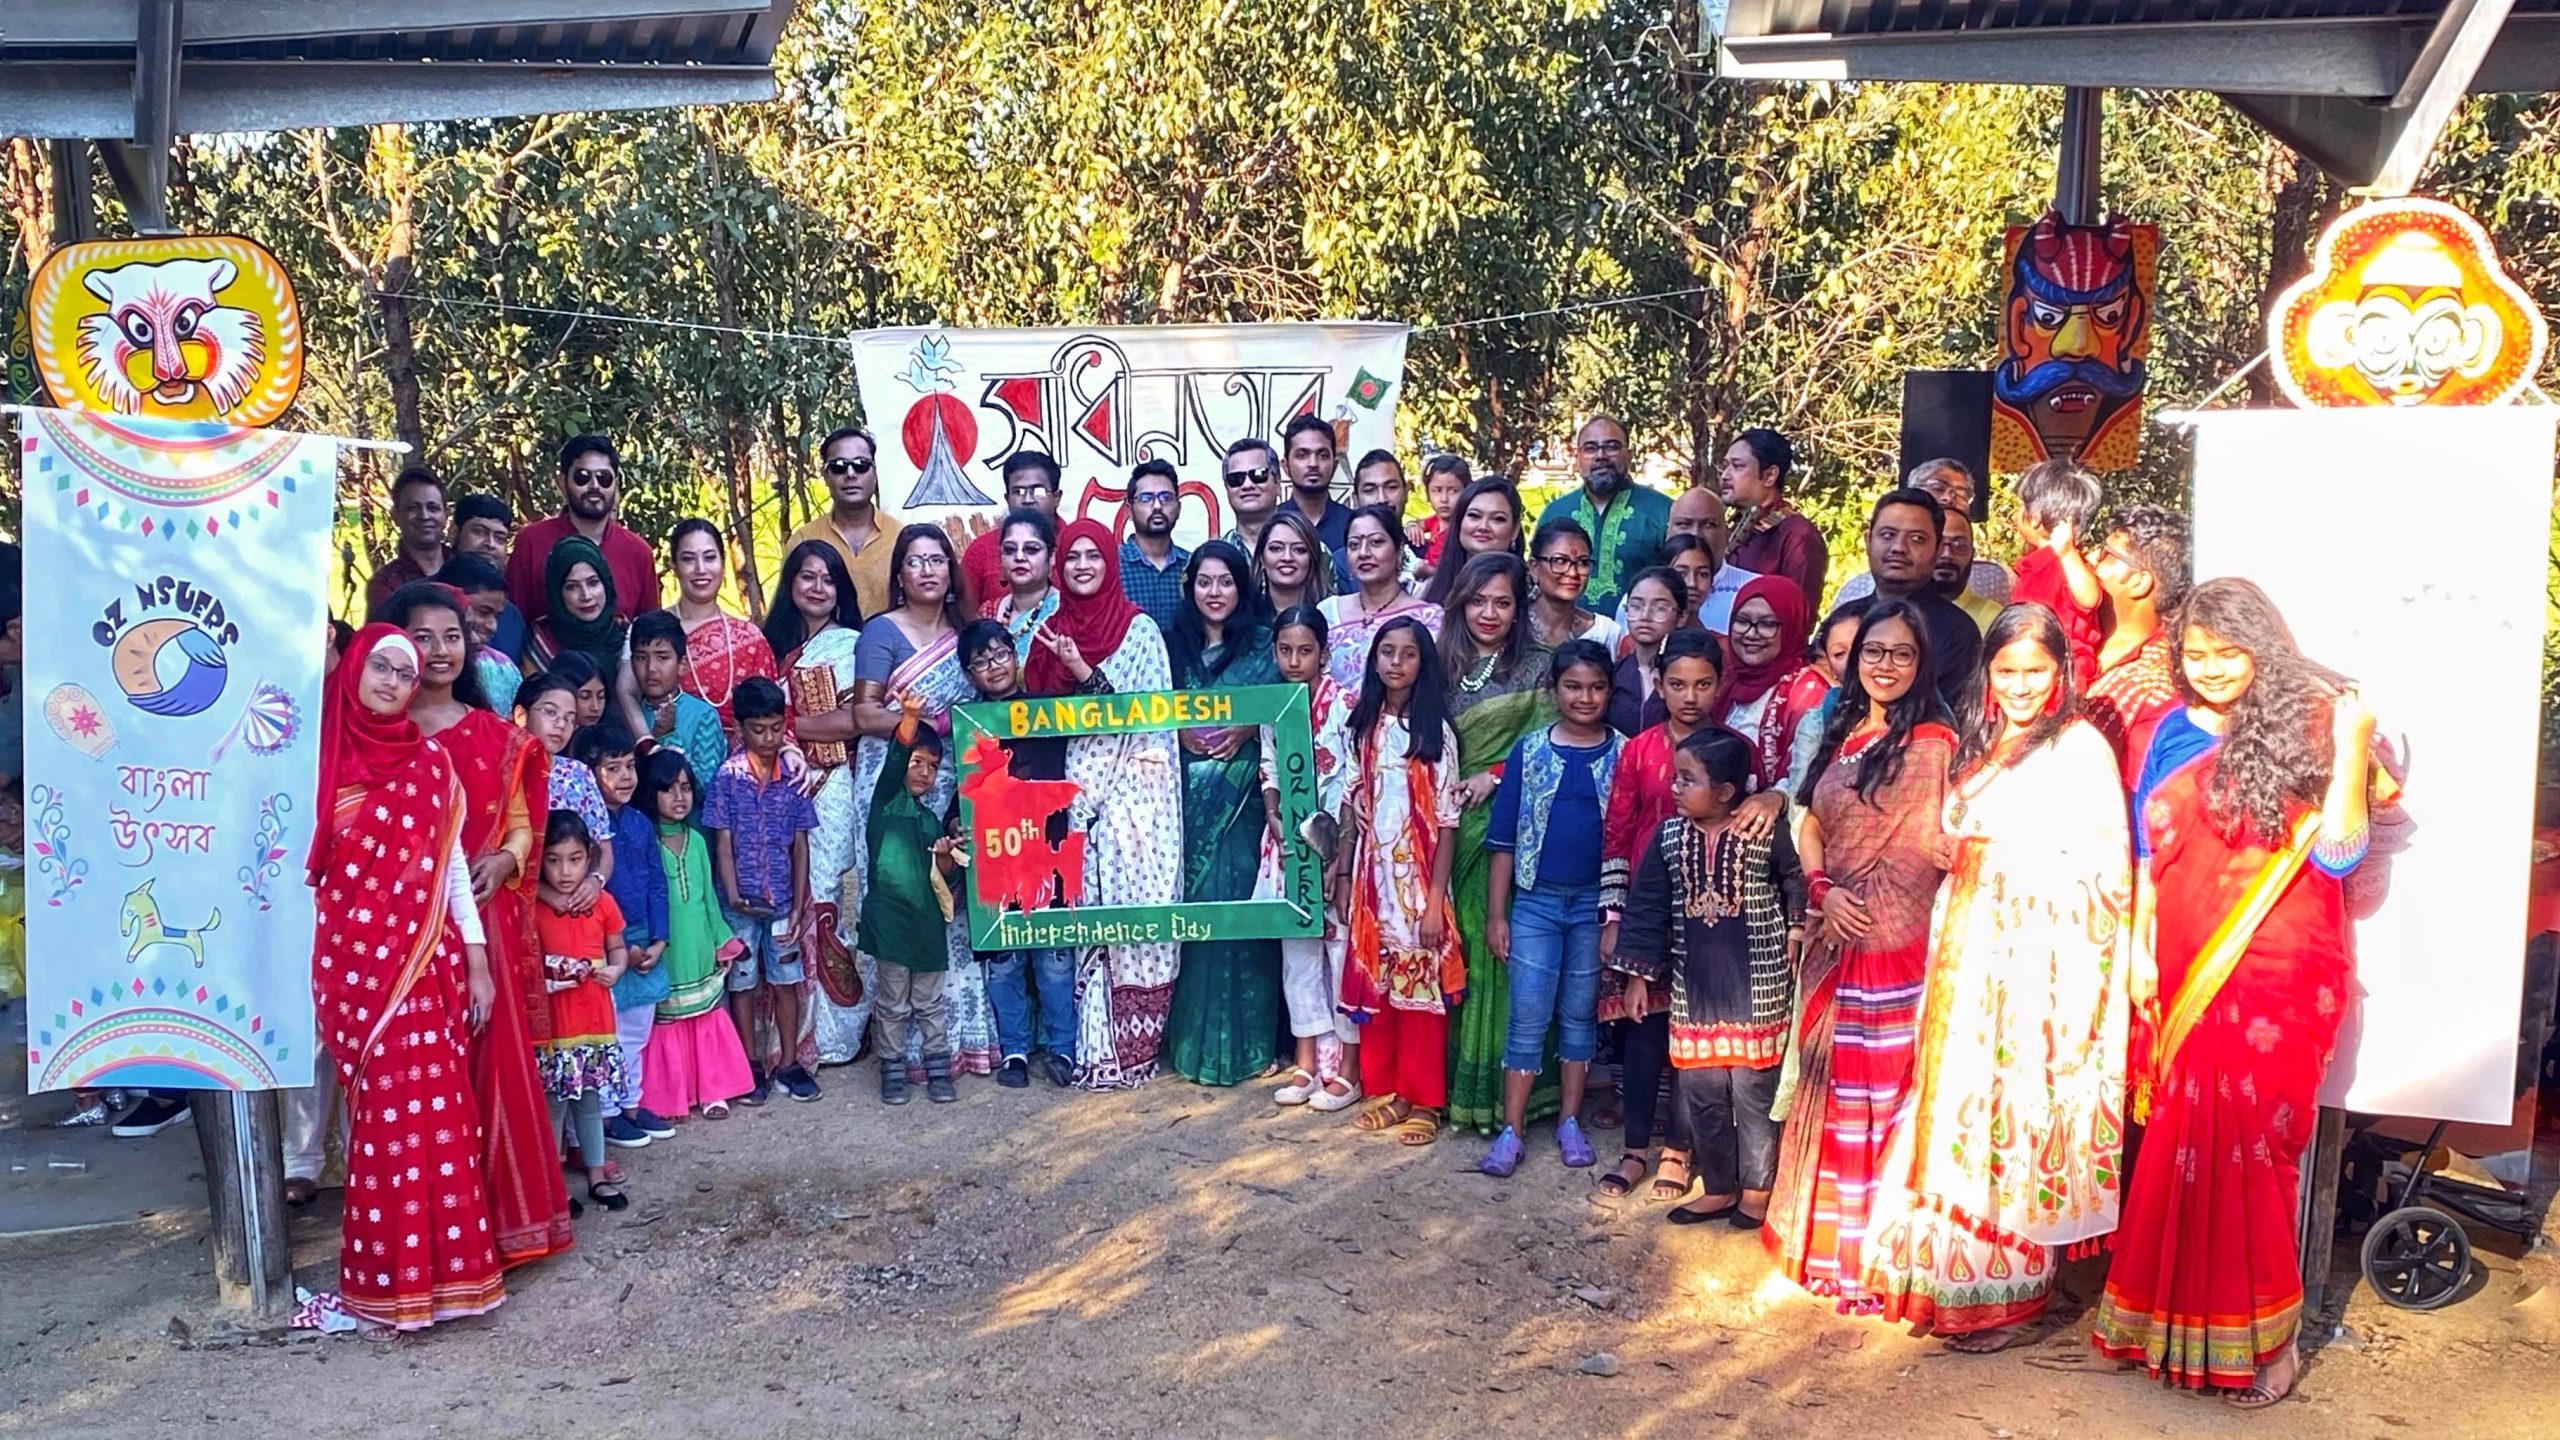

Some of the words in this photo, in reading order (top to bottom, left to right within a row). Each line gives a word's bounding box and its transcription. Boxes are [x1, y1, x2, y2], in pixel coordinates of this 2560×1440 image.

[92, 597, 128, 647] OZ
[135, 575, 239, 646] NSUERS
[1009, 695, 1232, 737] BANGLADESH
[117, 766, 212, 813] বাংলা
[109, 800, 216, 868] উৎসব
[985, 817, 1040, 858] 50th
[1000, 918, 1159, 947] Independence
[1171, 912, 1211, 941] Day
